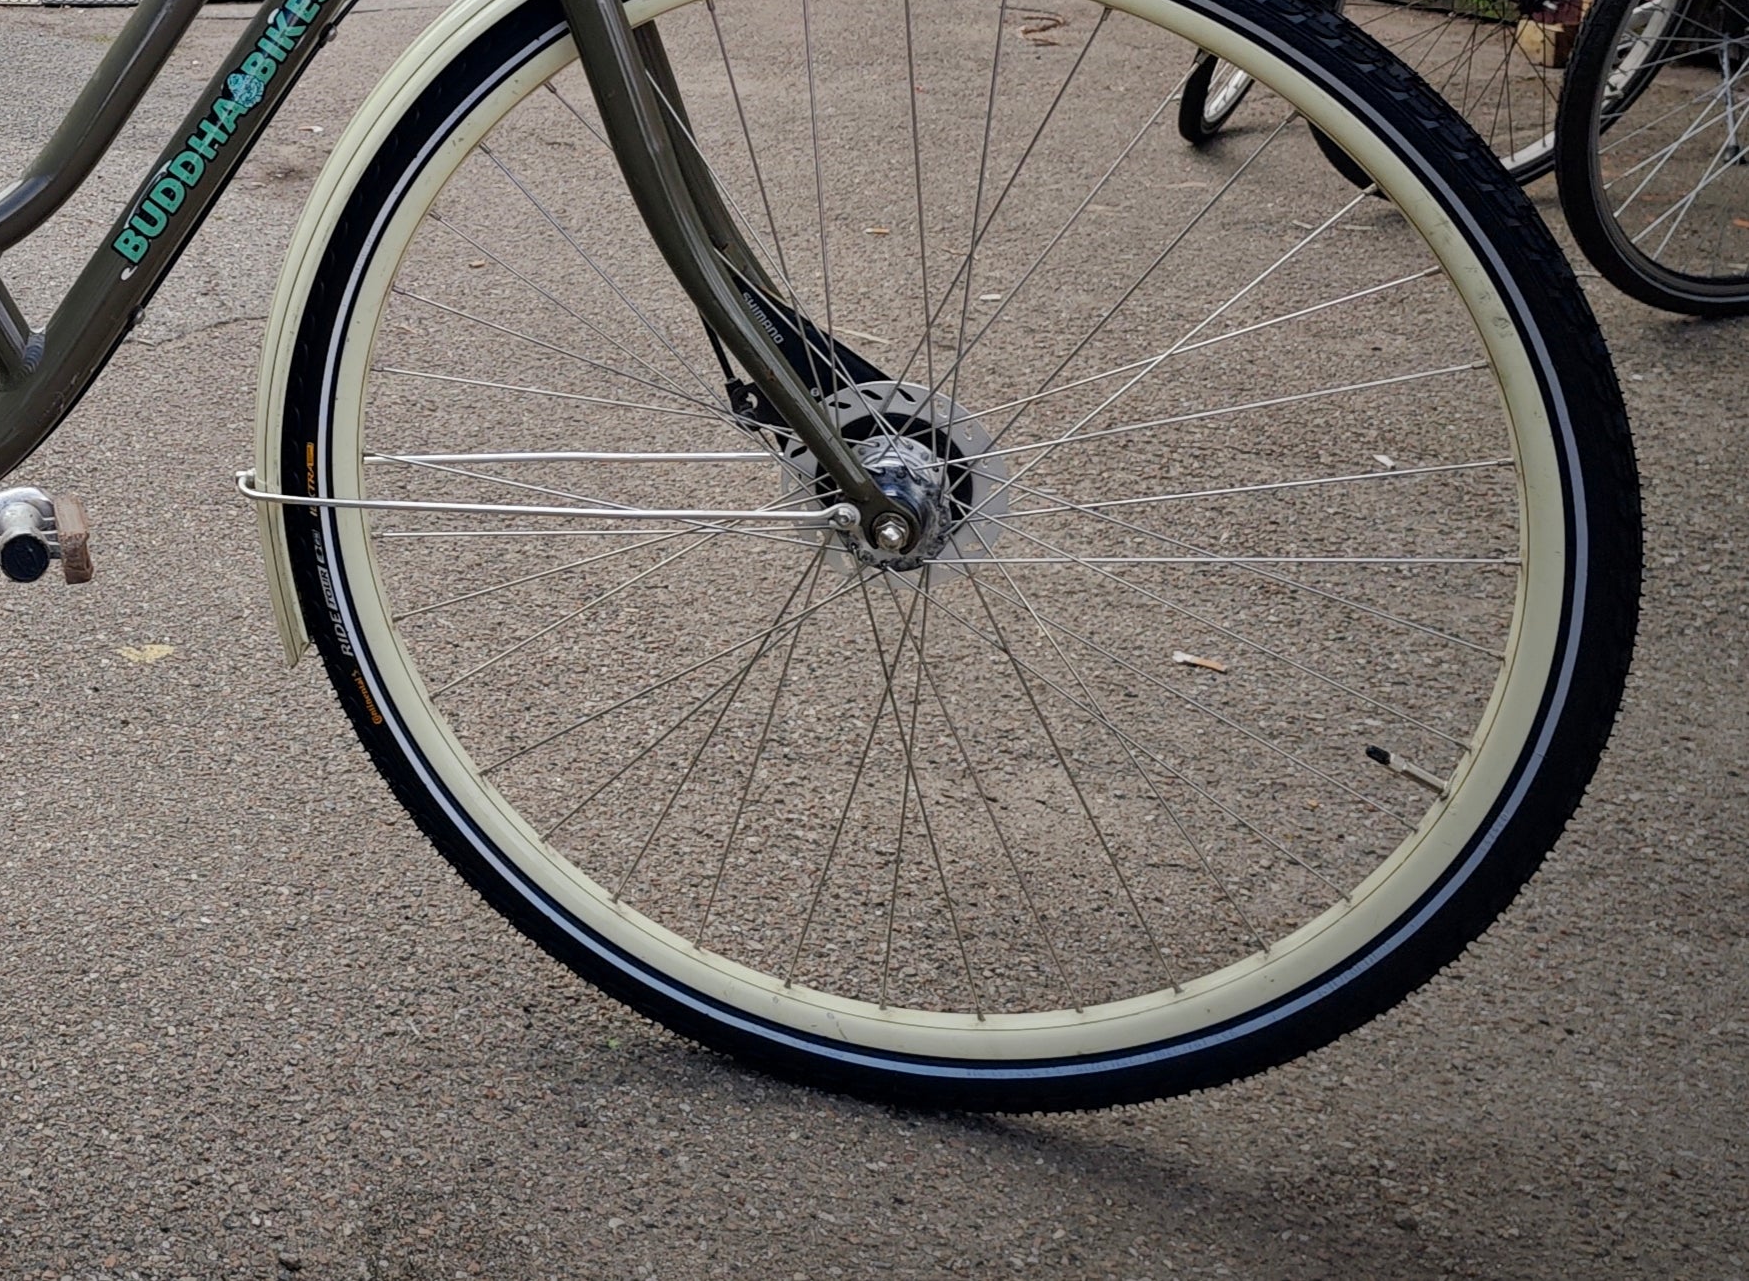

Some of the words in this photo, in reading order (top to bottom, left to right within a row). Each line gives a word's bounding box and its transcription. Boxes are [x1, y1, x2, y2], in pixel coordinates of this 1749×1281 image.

[112, 96, 249, 264] BUDDHA
[320, 568, 337, 610] TOUR
[331, 612, 354, 656] RIDE
